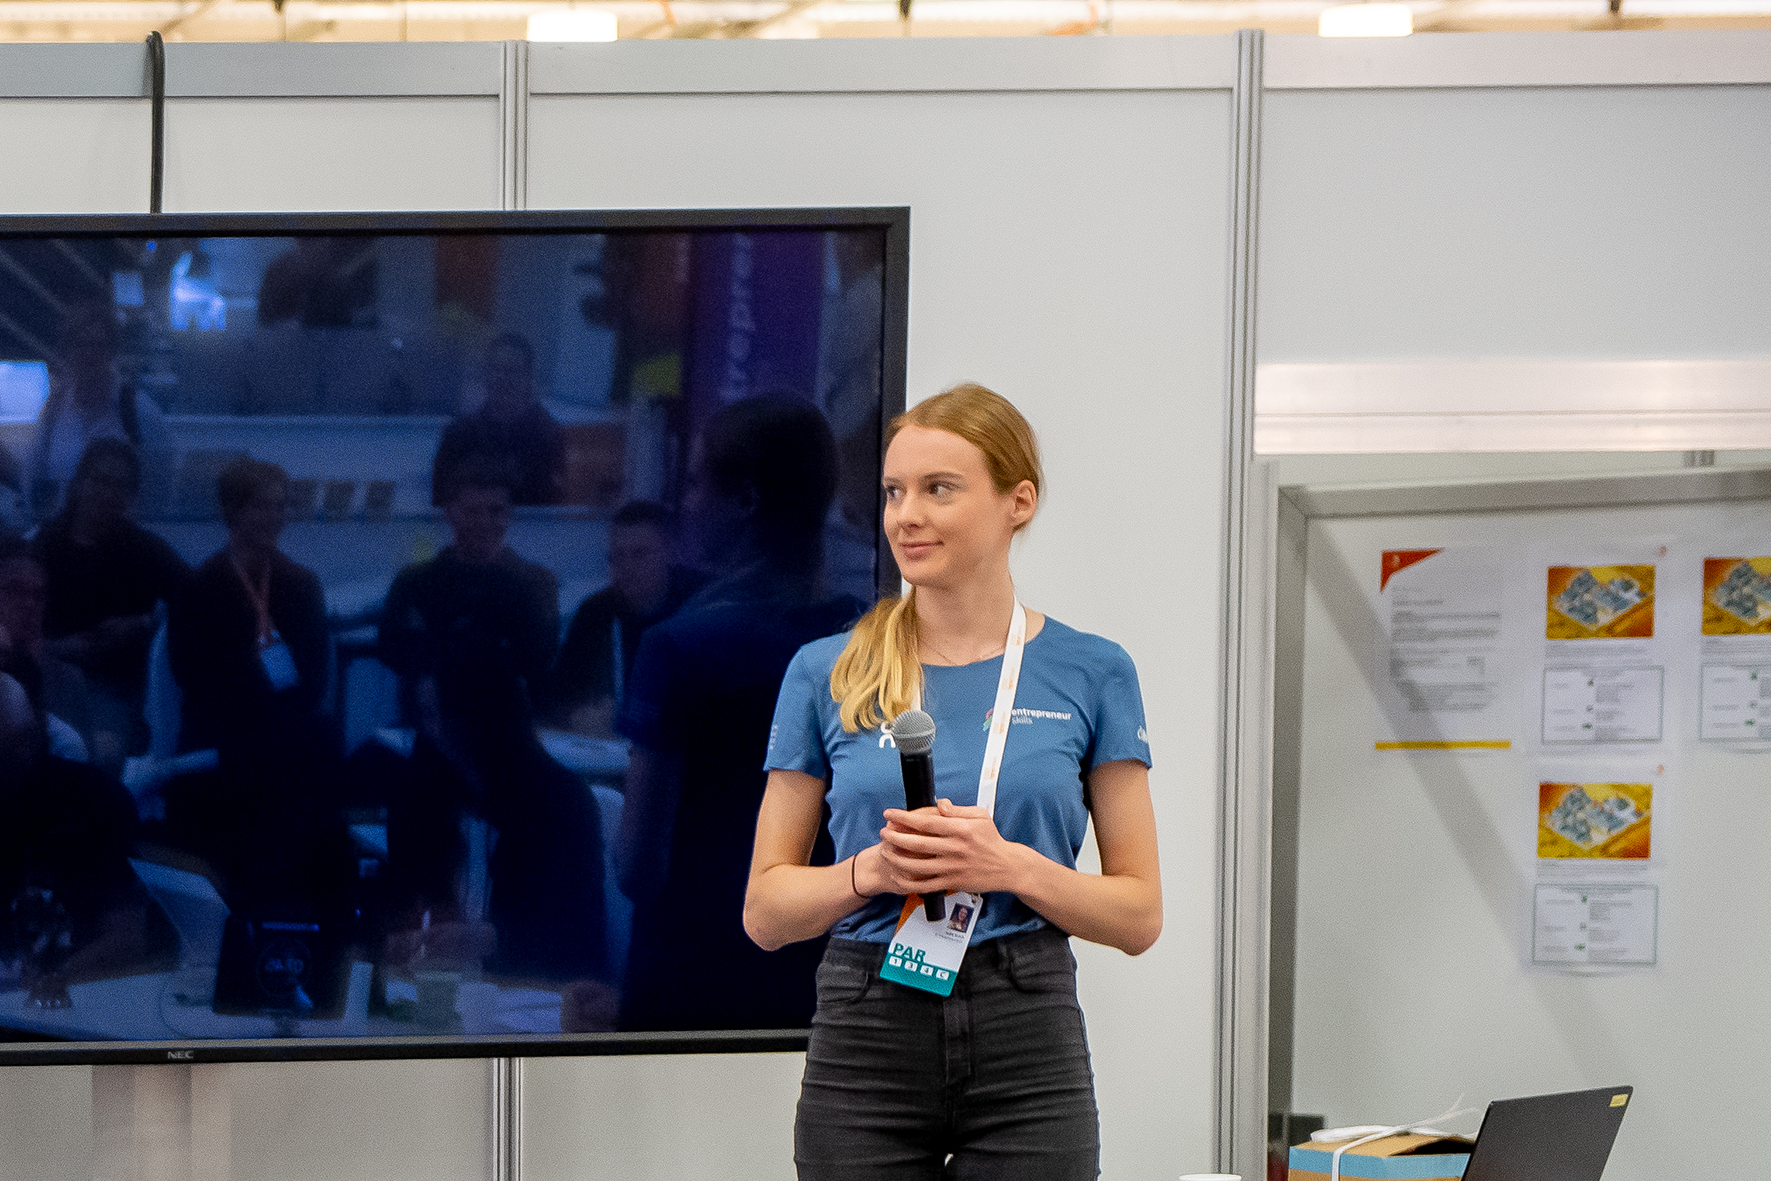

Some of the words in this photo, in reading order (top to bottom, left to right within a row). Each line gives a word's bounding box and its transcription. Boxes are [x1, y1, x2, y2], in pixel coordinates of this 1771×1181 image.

[1011, 708, 1072, 720] entrepreneur
[892, 942, 927, 961] PAR
[167, 1050, 194, 1059] NEC
